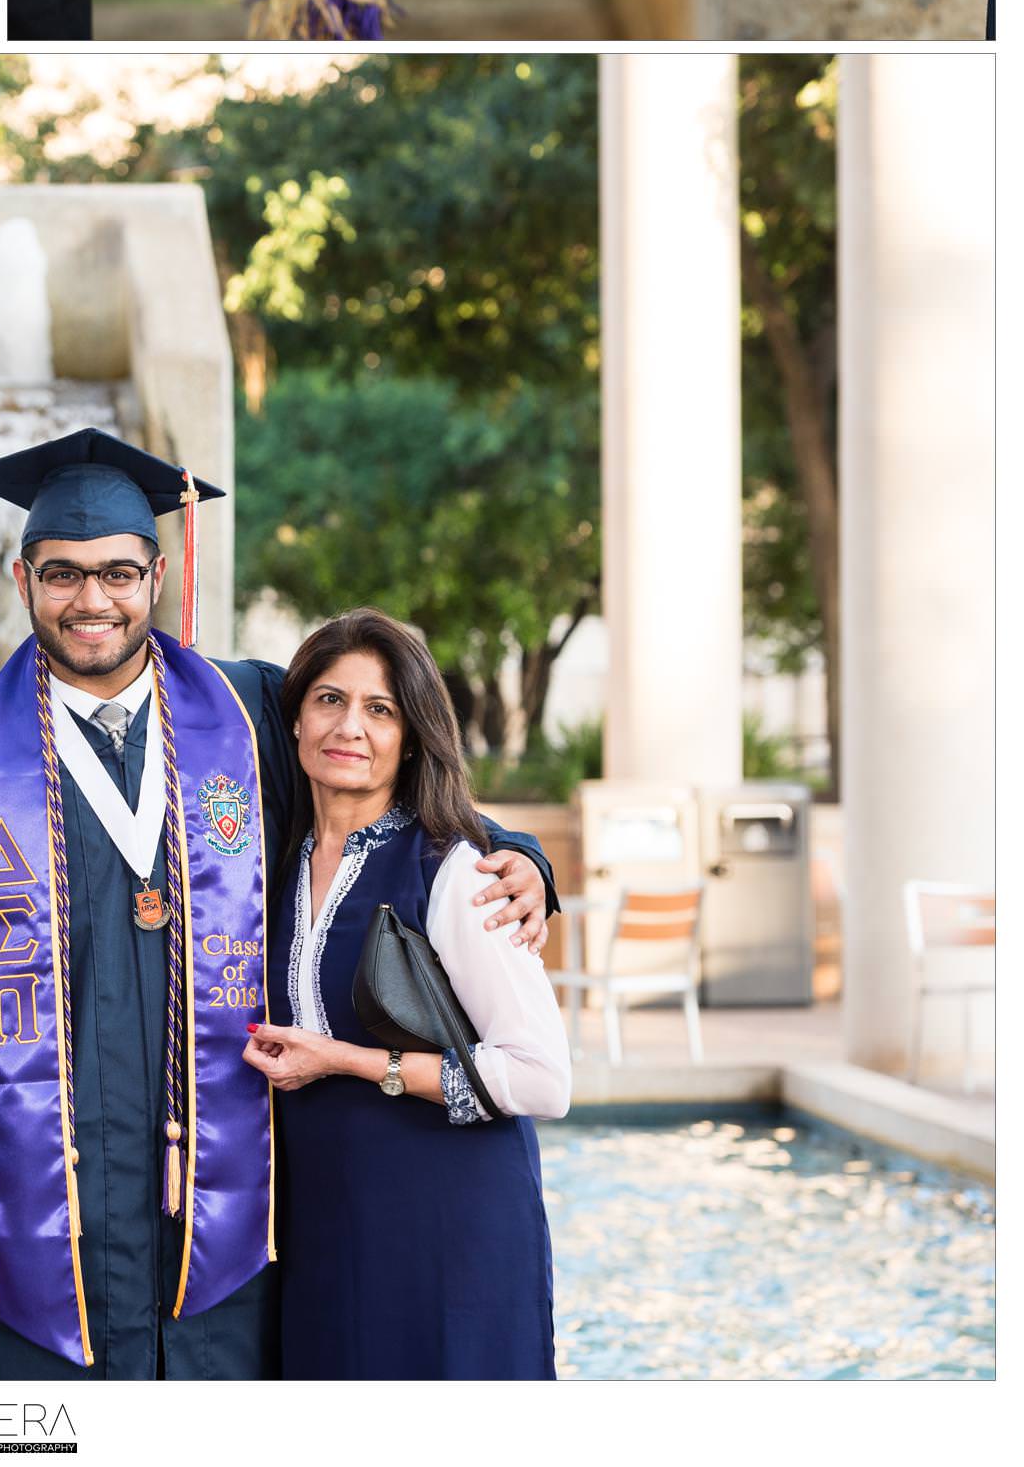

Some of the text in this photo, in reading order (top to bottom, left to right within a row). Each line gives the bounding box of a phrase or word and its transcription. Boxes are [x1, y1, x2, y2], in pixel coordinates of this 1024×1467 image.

[202, 934, 258, 956] Class
[223, 960, 248, 981] of
[209, 986, 258, 1008] 2018
